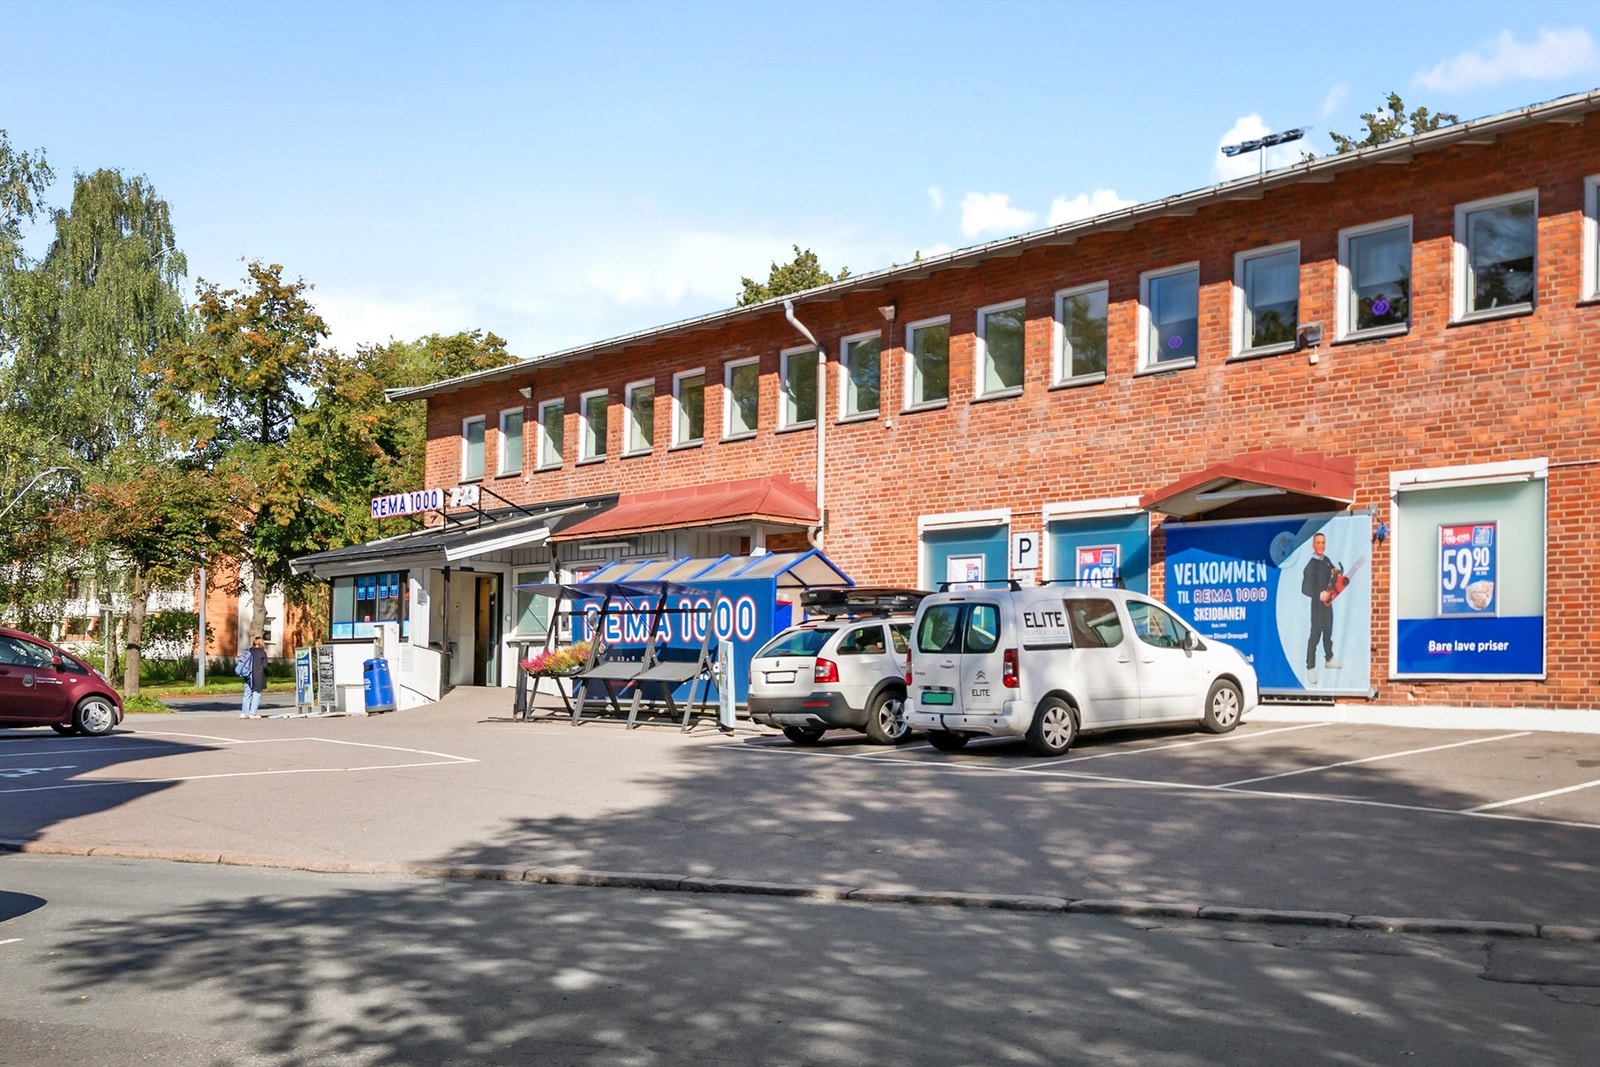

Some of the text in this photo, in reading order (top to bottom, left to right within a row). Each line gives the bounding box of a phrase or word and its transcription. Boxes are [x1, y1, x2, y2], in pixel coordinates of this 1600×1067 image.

[372, 490, 438, 516] REMA 1000
[1019, 537, 1032, 564] P
[1173, 559, 1267, 586] VELKOMMEN
[1443, 546, 1490, 590] 59 90
[1177, 587, 1267, 604] TIL REMA 1000
[678, 594, 758, 643] 1000
[1023, 611, 1065, 628] ELITE
[1193, 606, 1246, 621] SKEIDBANEN
[1428, 639, 1509, 653] Bare lave priser
[971, 689, 991, 697] ELITE
